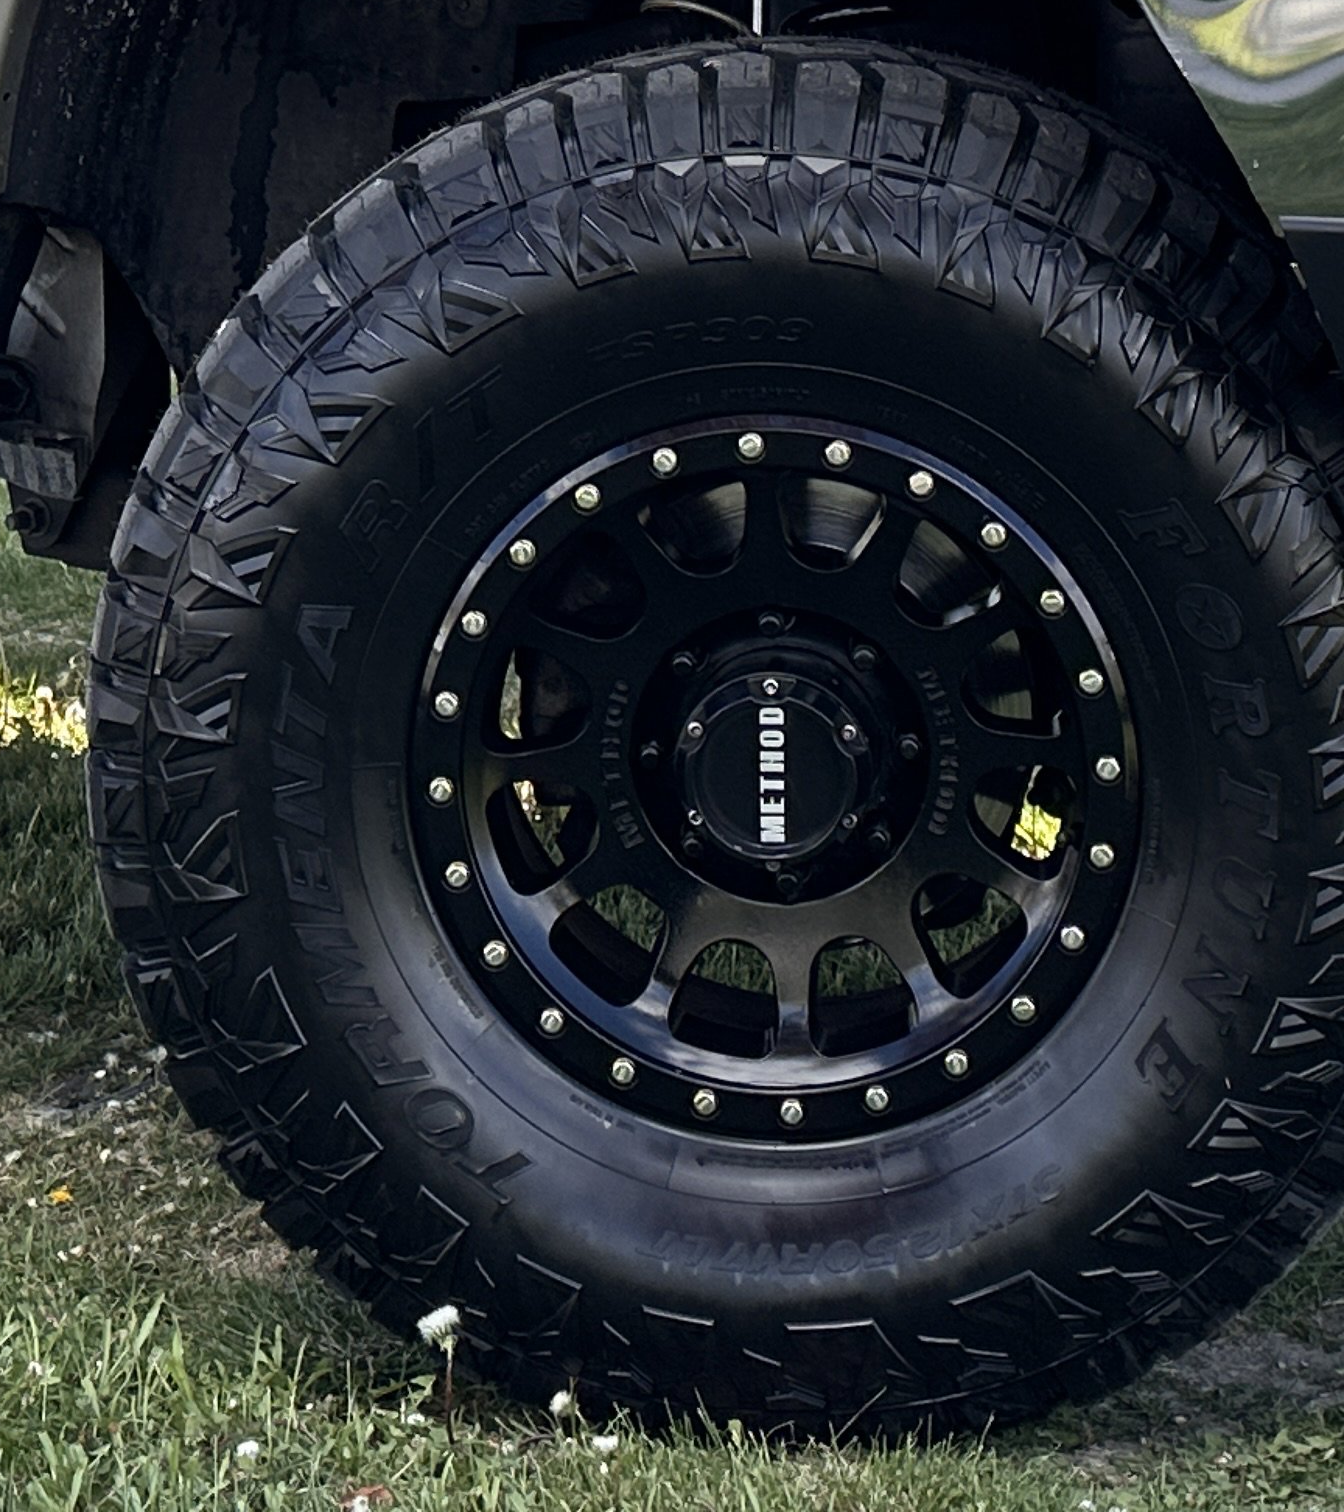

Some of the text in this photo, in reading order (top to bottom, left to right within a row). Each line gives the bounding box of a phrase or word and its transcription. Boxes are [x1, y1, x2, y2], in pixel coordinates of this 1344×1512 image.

[338, 364, 504, 573] R/T
[600, 679, 645, 849] METHOD
[759, 706, 787, 844] METHOD
[1117, 496, 1282, 1113] FORTUNE
[271, 602, 534, 1206] TORMENTA
